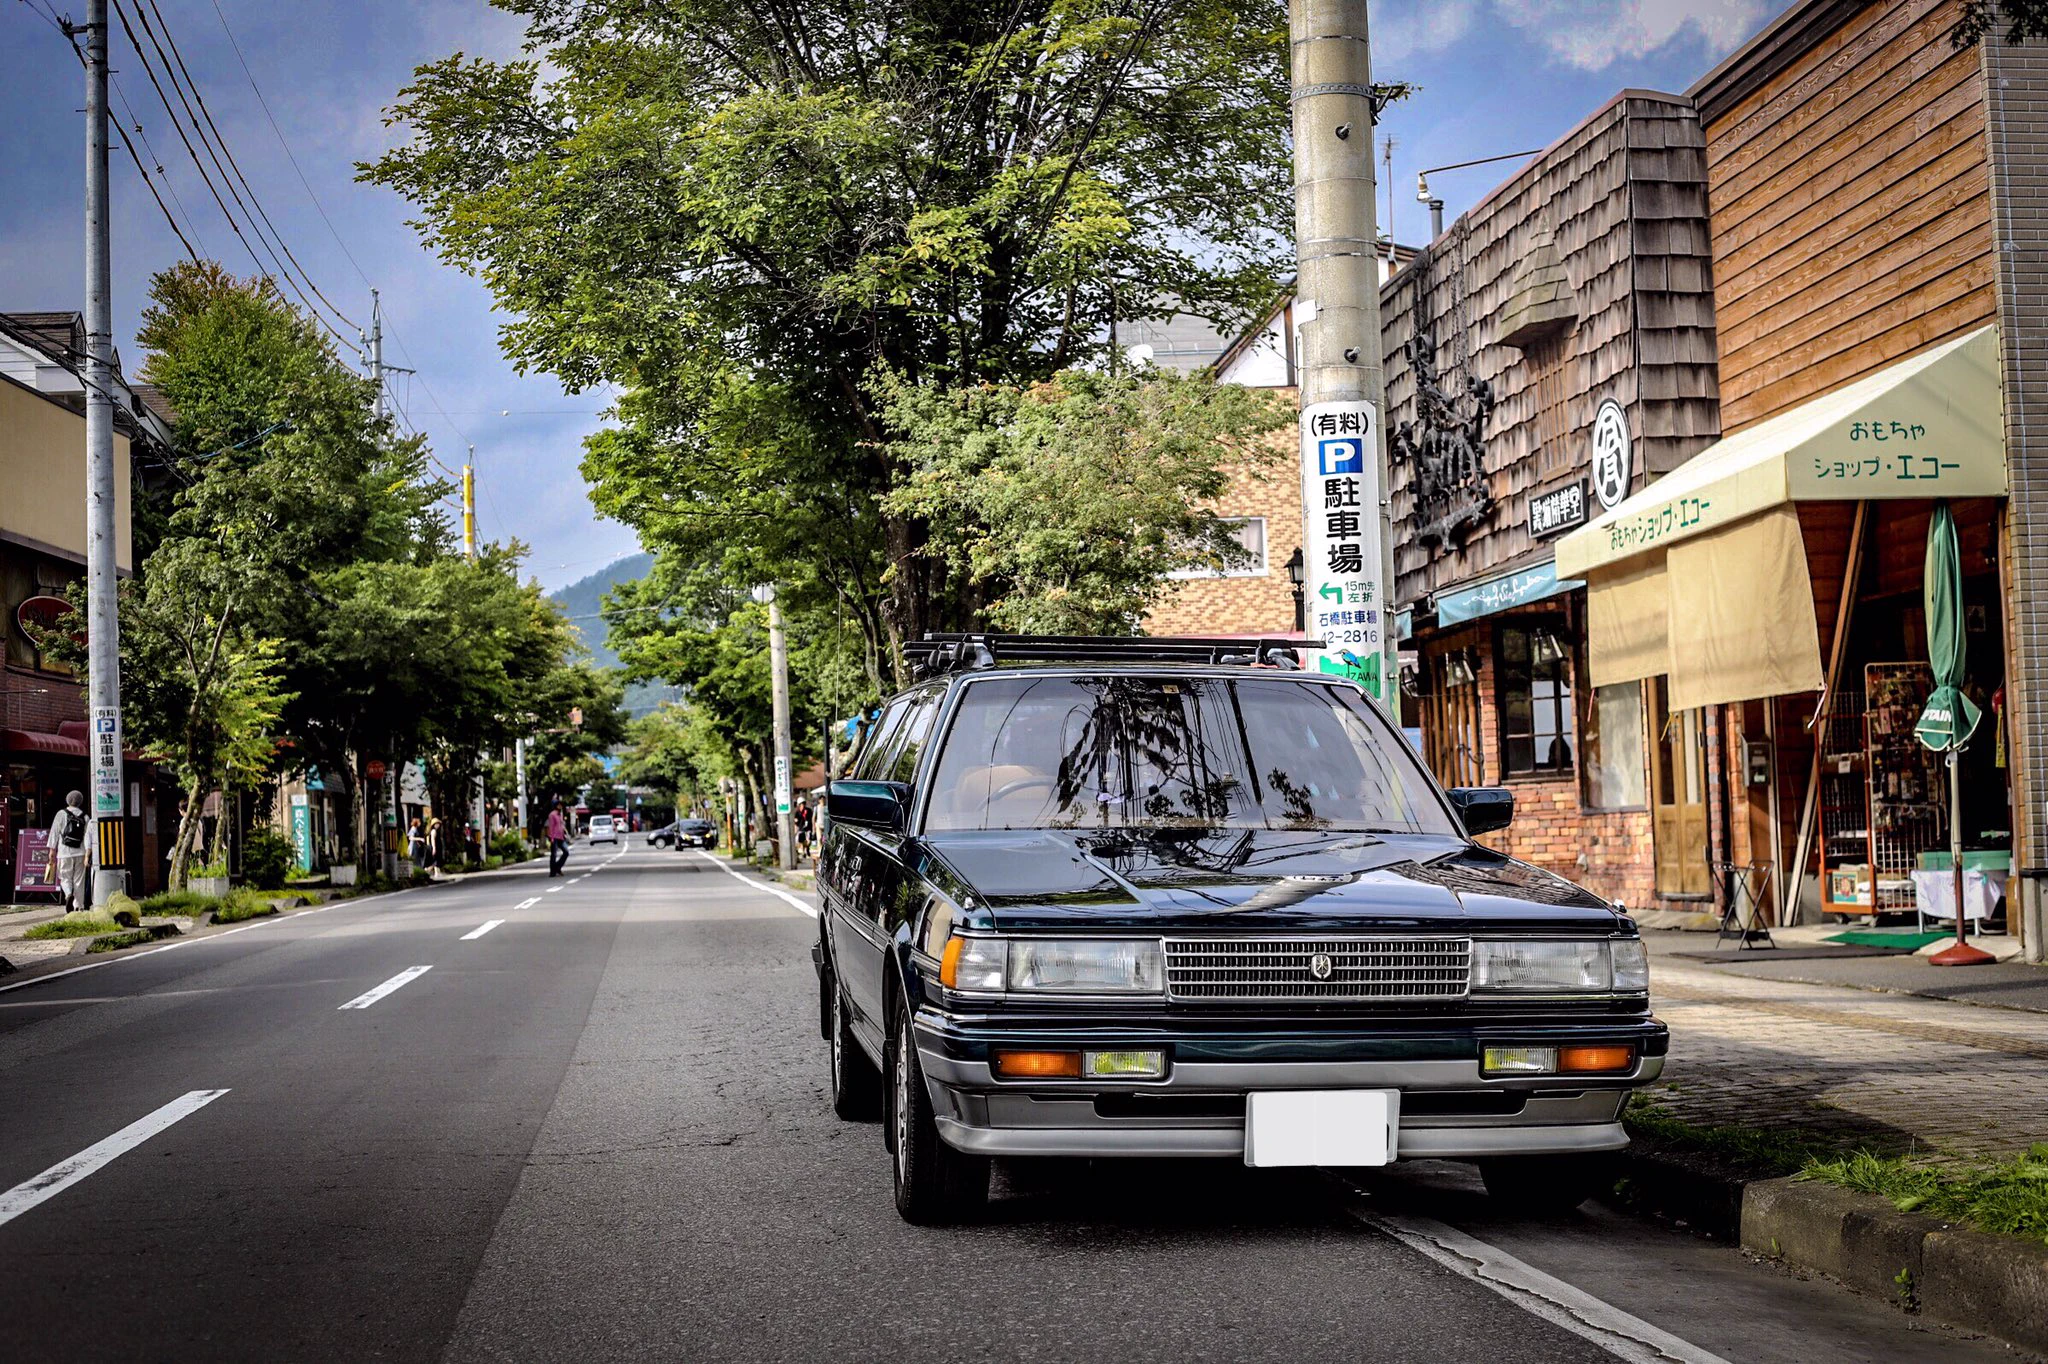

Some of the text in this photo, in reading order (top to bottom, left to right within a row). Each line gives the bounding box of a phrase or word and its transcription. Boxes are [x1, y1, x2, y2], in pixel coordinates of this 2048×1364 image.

[1311, 411, 1369, 437] (有料)
[1850, 421, 1925, 441] おもちゃ
[1324, 442, 1356, 474] P
[1814, 455, 1960, 480] ショップ・エコー
[1324, 476, 1363, 574] 駐車場
[1344, 580, 1375, 592] 15m先
[1347, 591, 1373, 603] 左折
[1319, 610, 1378, 627] 石橋駐車場
[1320, 630, 1378, 644] 42-2816
[100, 720, 113, 732] P
[99, 733, 114, 767] 駐車場
